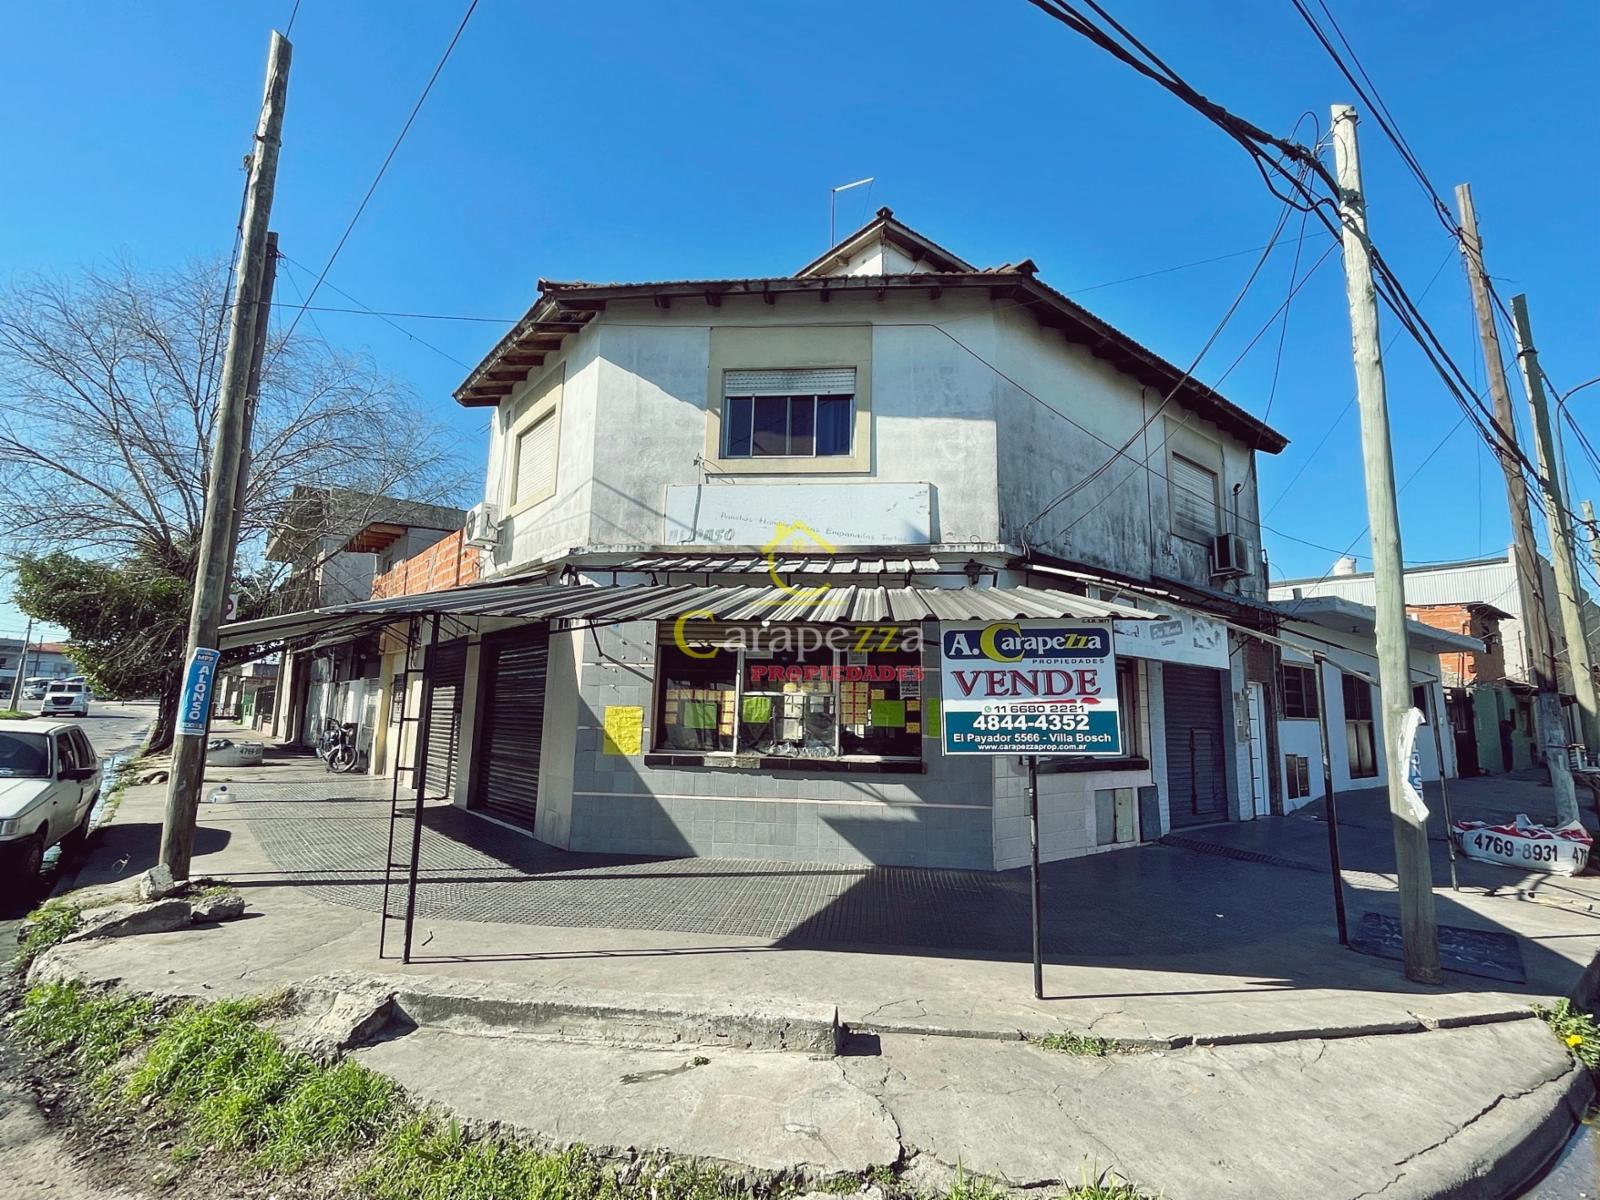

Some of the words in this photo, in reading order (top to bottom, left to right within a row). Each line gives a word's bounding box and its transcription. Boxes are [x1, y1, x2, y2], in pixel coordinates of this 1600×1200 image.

[949, 633, 980, 656] A.
[979, 623, 1102, 664] Carapezza
[188, 665, 210, 720] ALONSO
[951, 669, 1102, 697] VENDE
[993, 705, 1007, 713] 11
[1010, 705, 1046, 713] 6680
[1049, 704, 1085, 713] 2221
[972, 714, 1090, 731] 4844-4352
[953, 734, 964, 743] El
[967, 733, 1011, 746] Payador
[1014, 733, 1040, 743] 5566
[1049, 733, 1073, 743] Villa
[1076, 733, 1112, 743] Bosch
[978, 743, 1088, 751] www.carapezzaprop.com.ar
[1473, 832, 1558, 862] 4769-8931
